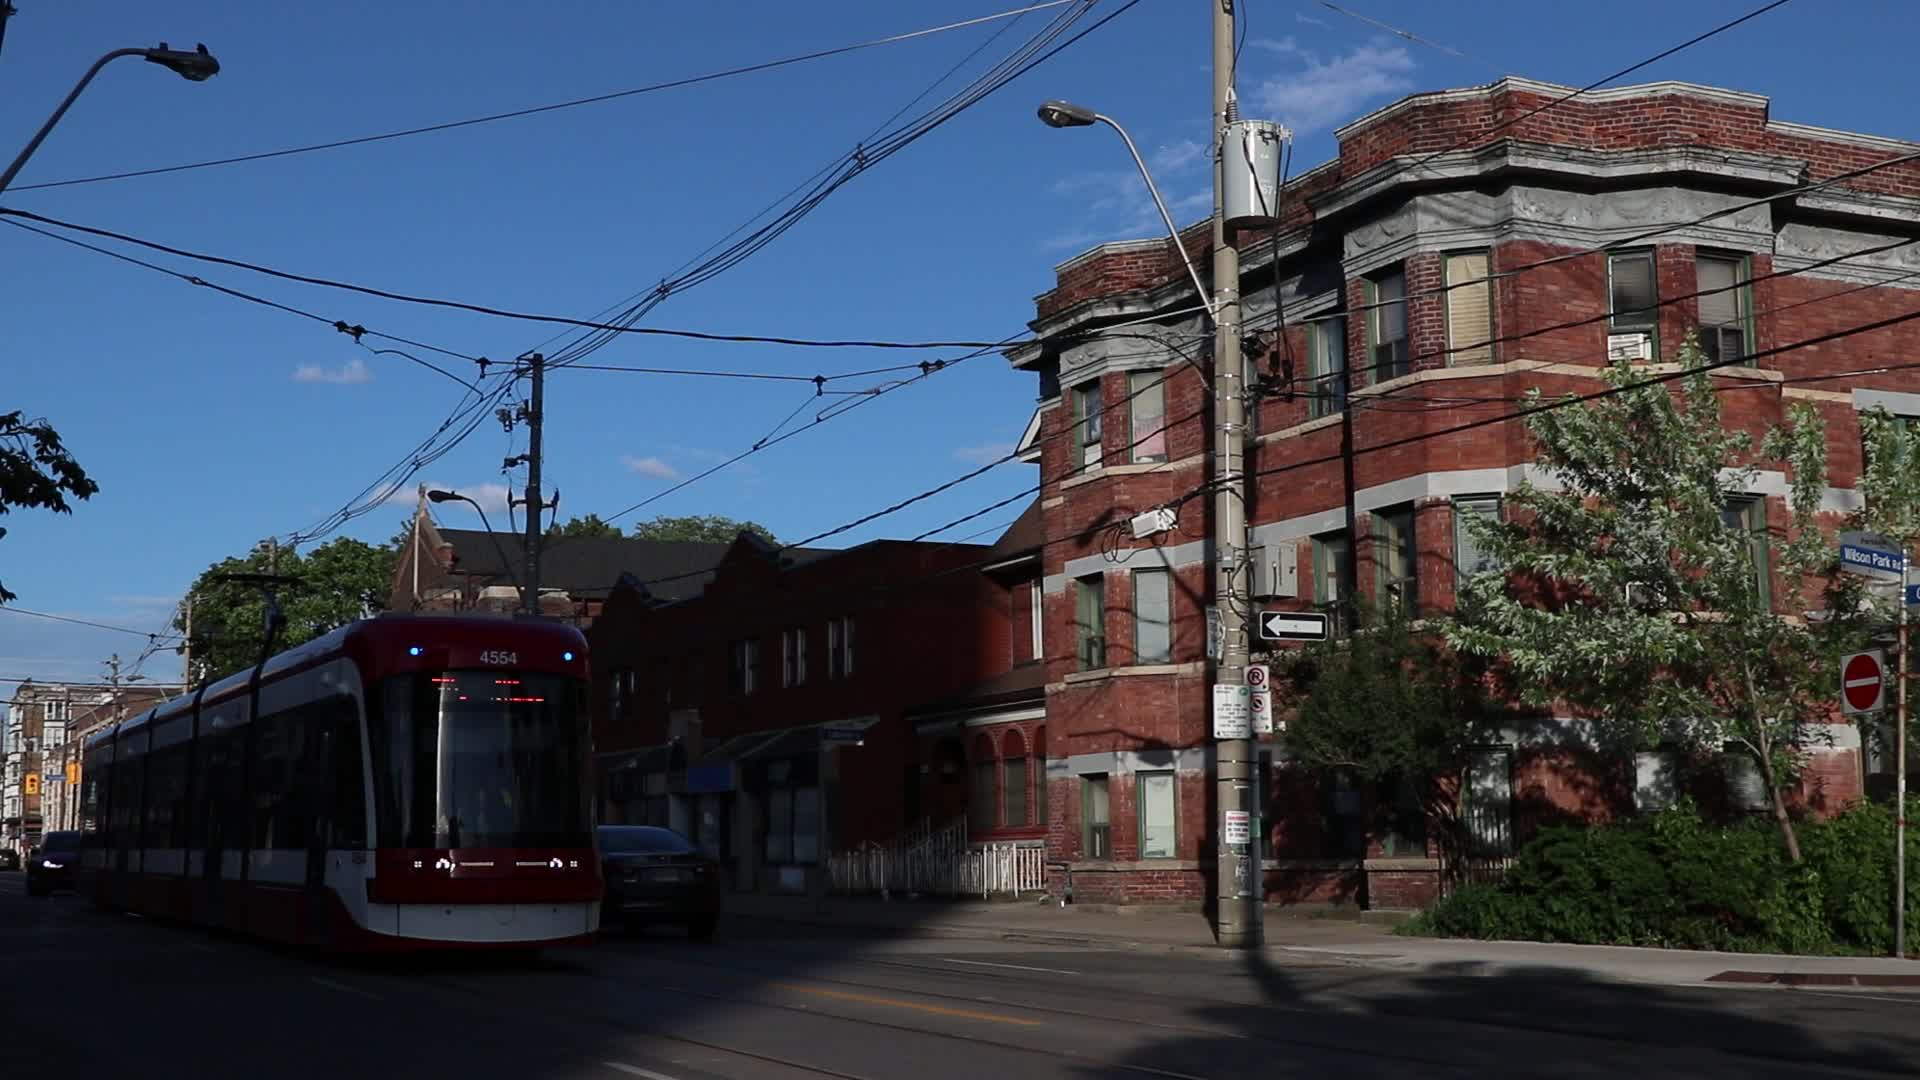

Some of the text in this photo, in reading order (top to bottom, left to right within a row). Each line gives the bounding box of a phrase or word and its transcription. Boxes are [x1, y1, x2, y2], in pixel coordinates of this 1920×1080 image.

[1844, 547, 1902, 570] Wilson Park Rd
[480, 650, 517, 665] 4554
